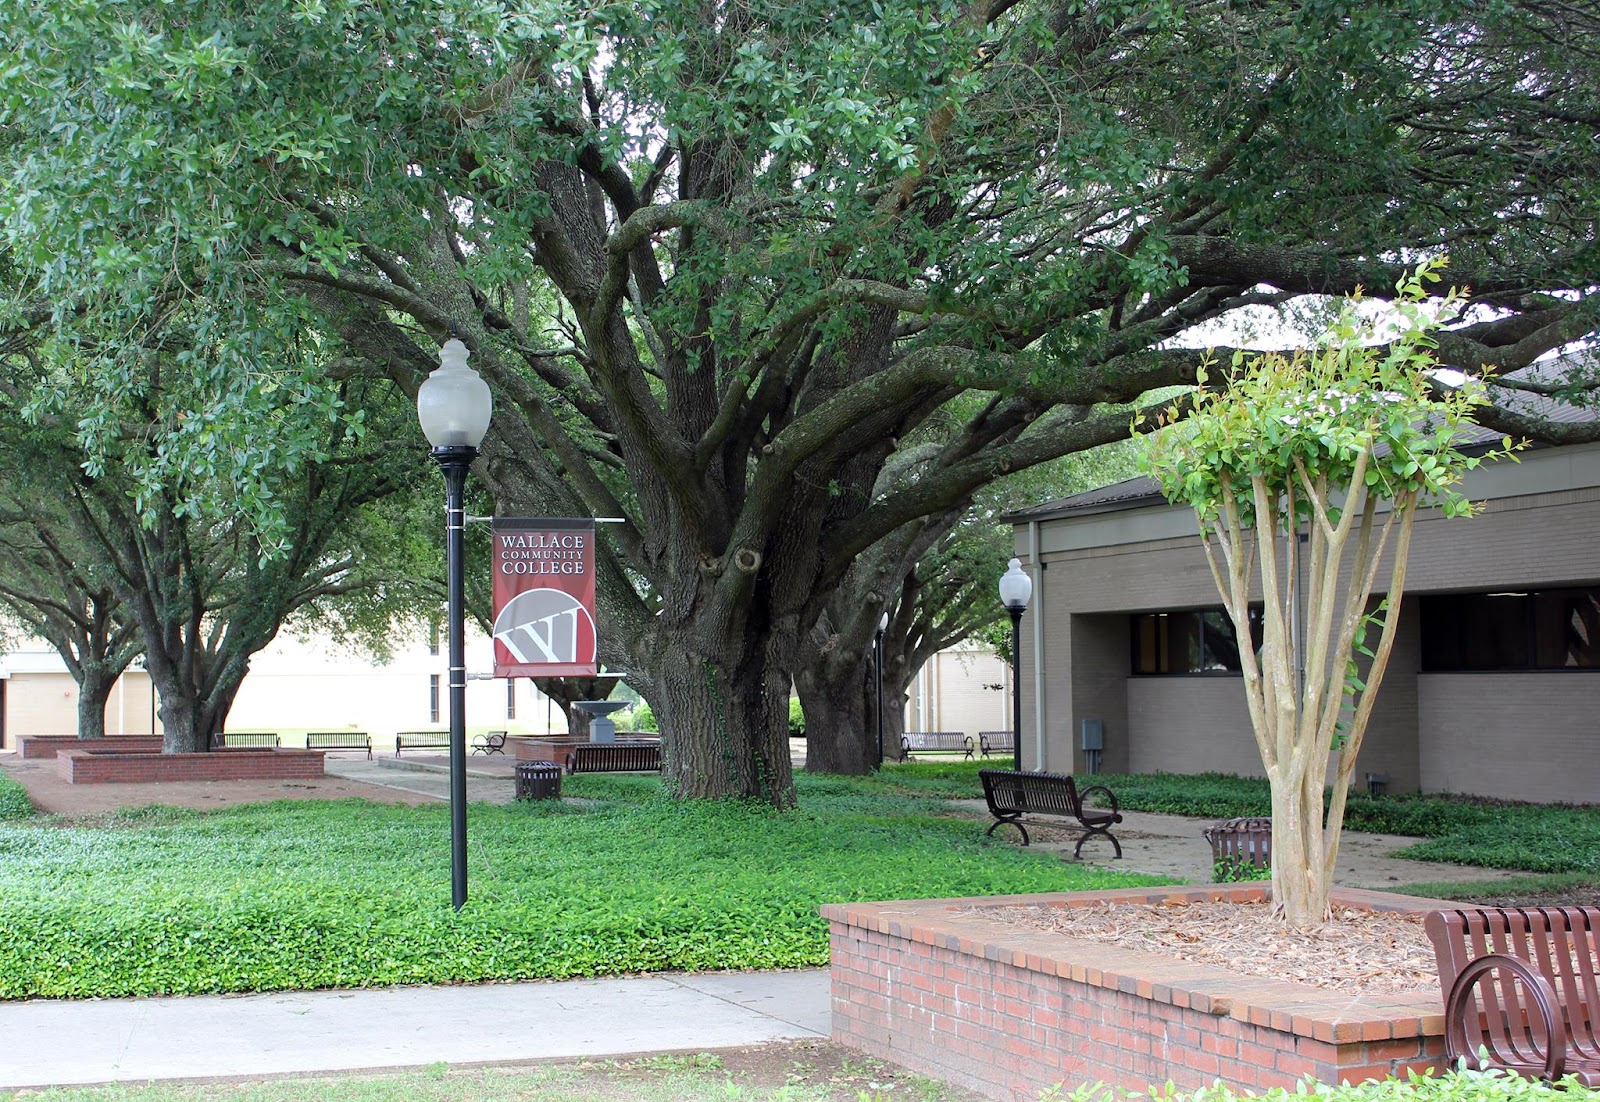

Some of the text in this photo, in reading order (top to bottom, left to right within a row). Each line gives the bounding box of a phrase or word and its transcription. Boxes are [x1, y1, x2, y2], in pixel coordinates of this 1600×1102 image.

[501, 535, 584, 548] WALLACE
[501, 551, 583, 559] COMMUNITY
[502, 561, 584, 574] COLLEGE
